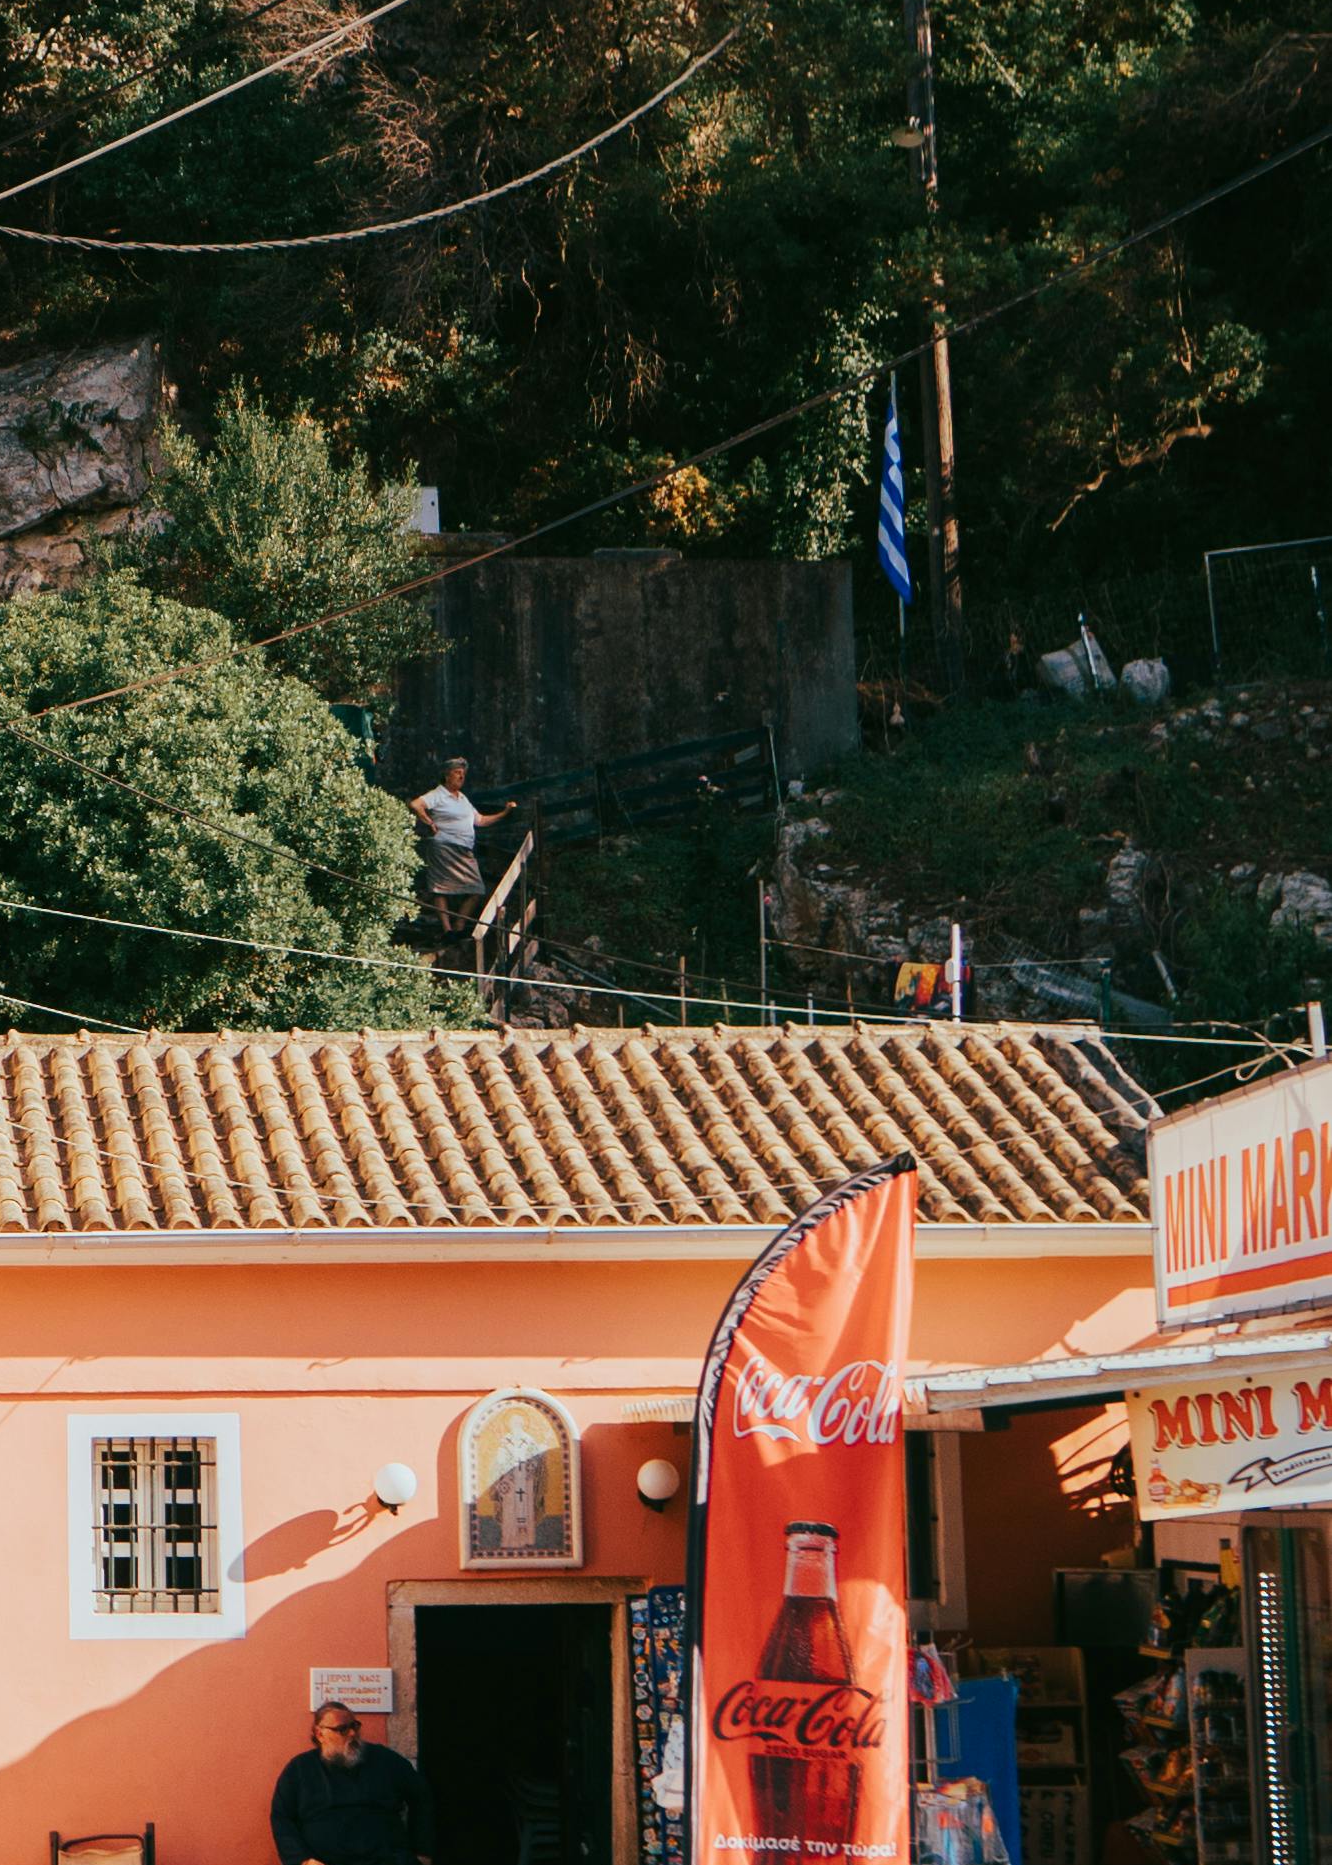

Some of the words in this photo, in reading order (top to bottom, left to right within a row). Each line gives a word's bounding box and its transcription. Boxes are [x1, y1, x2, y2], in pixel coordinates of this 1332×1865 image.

[1165, 1155, 1227, 1274] MINI
[733, 1355, 899, 1446] Coca-Cola
[1149, 1386, 1279, 1452] MINI
[713, 1680, 886, 1749] Coca-Cola
[713, 1833, 801, 1853] Δοκίμασέ
[804, 1838, 838, 1856] την
[841, 1840, 898, 1859] τώρα!
